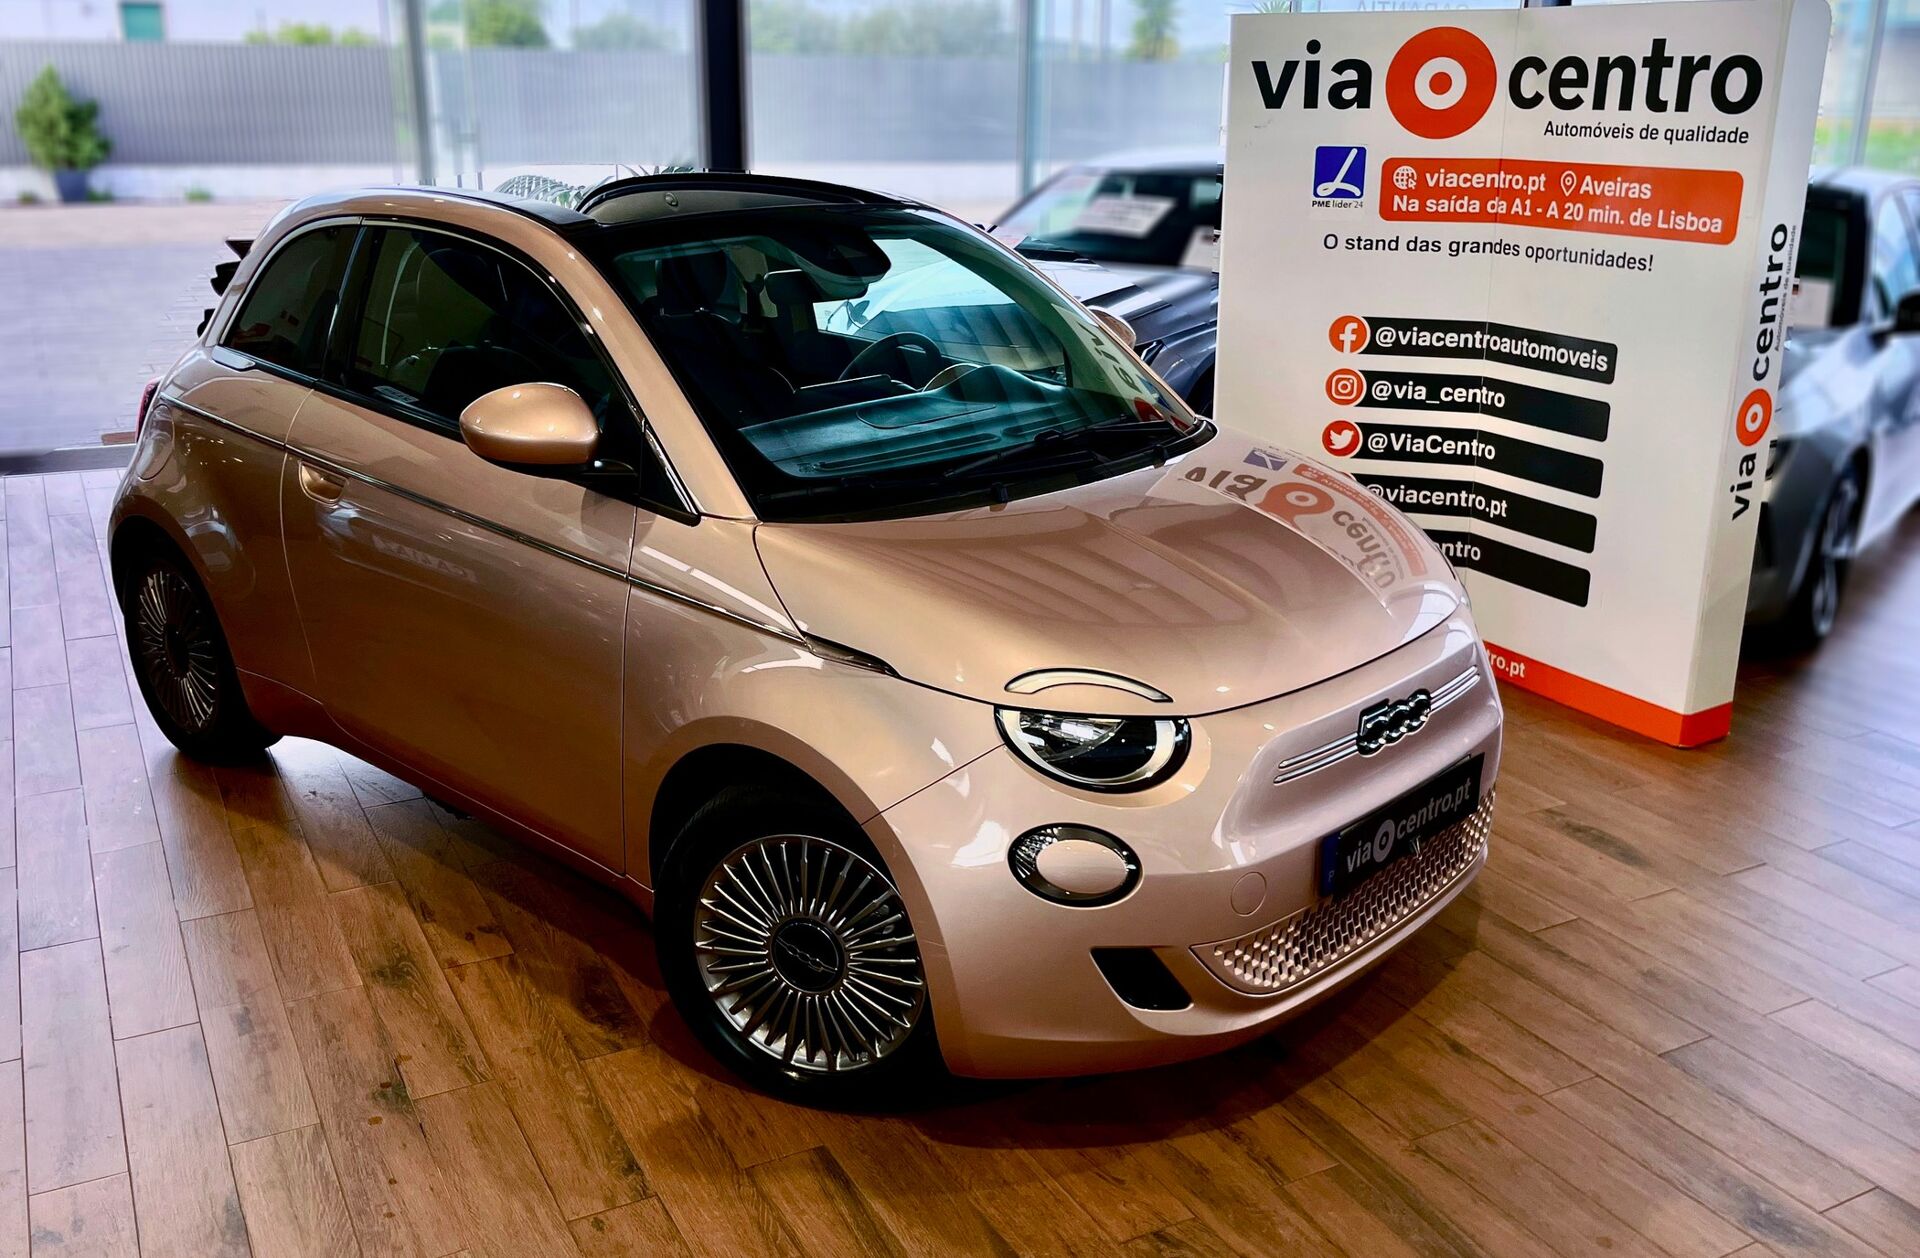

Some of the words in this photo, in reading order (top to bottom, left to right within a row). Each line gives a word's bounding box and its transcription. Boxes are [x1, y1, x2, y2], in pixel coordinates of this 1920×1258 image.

[1251, 39, 1373, 110] via
[1508, 38, 1763, 115] centro
[1544, 120, 1634, 139] Automóveis
[1639, 124, 1659, 140] de
[1664, 125, 1749, 144] qualidade
[1425, 168, 1546, 195] viacentro.pt
[1580, 175, 1652, 199] Aveiras
[1311, 200, 1331, 208] PME
[1392, 195, 1420, 212] Na
[1425, 194, 1480, 213] saída
[1486, 198, 1507, 214] da
[1511, 197, 1531, 216] A1
[1546, 201, 1559, 219] A
[1563, 202, 1583, 221] 20
[1588, 205, 1625, 225] min.
[1629, 207, 1652, 227] de
[1657, 209, 1722, 233] Lisboa
[1323, 233, 1338, 250] O
[1345, 235, 1399, 251] stand
[1406, 236, 1442, 252] das
[1448, 238, 1520, 257] grandes
[1525, 245, 1654, 271] oportunidades!
[1375, 326, 1609, 372] @viacentroautomoveis
[1729, 452, 1757, 521] via
[1752, 223, 1788, 381] centro
[1371, 380, 1506, 408] @via_centro
[1367, 432, 1496, 460] @ViaCentro
[1436, 541, 1481, 561] ntro
[1346, 839, 1371, 873] via
[1396, 776, 1472, 841] centro.pt
